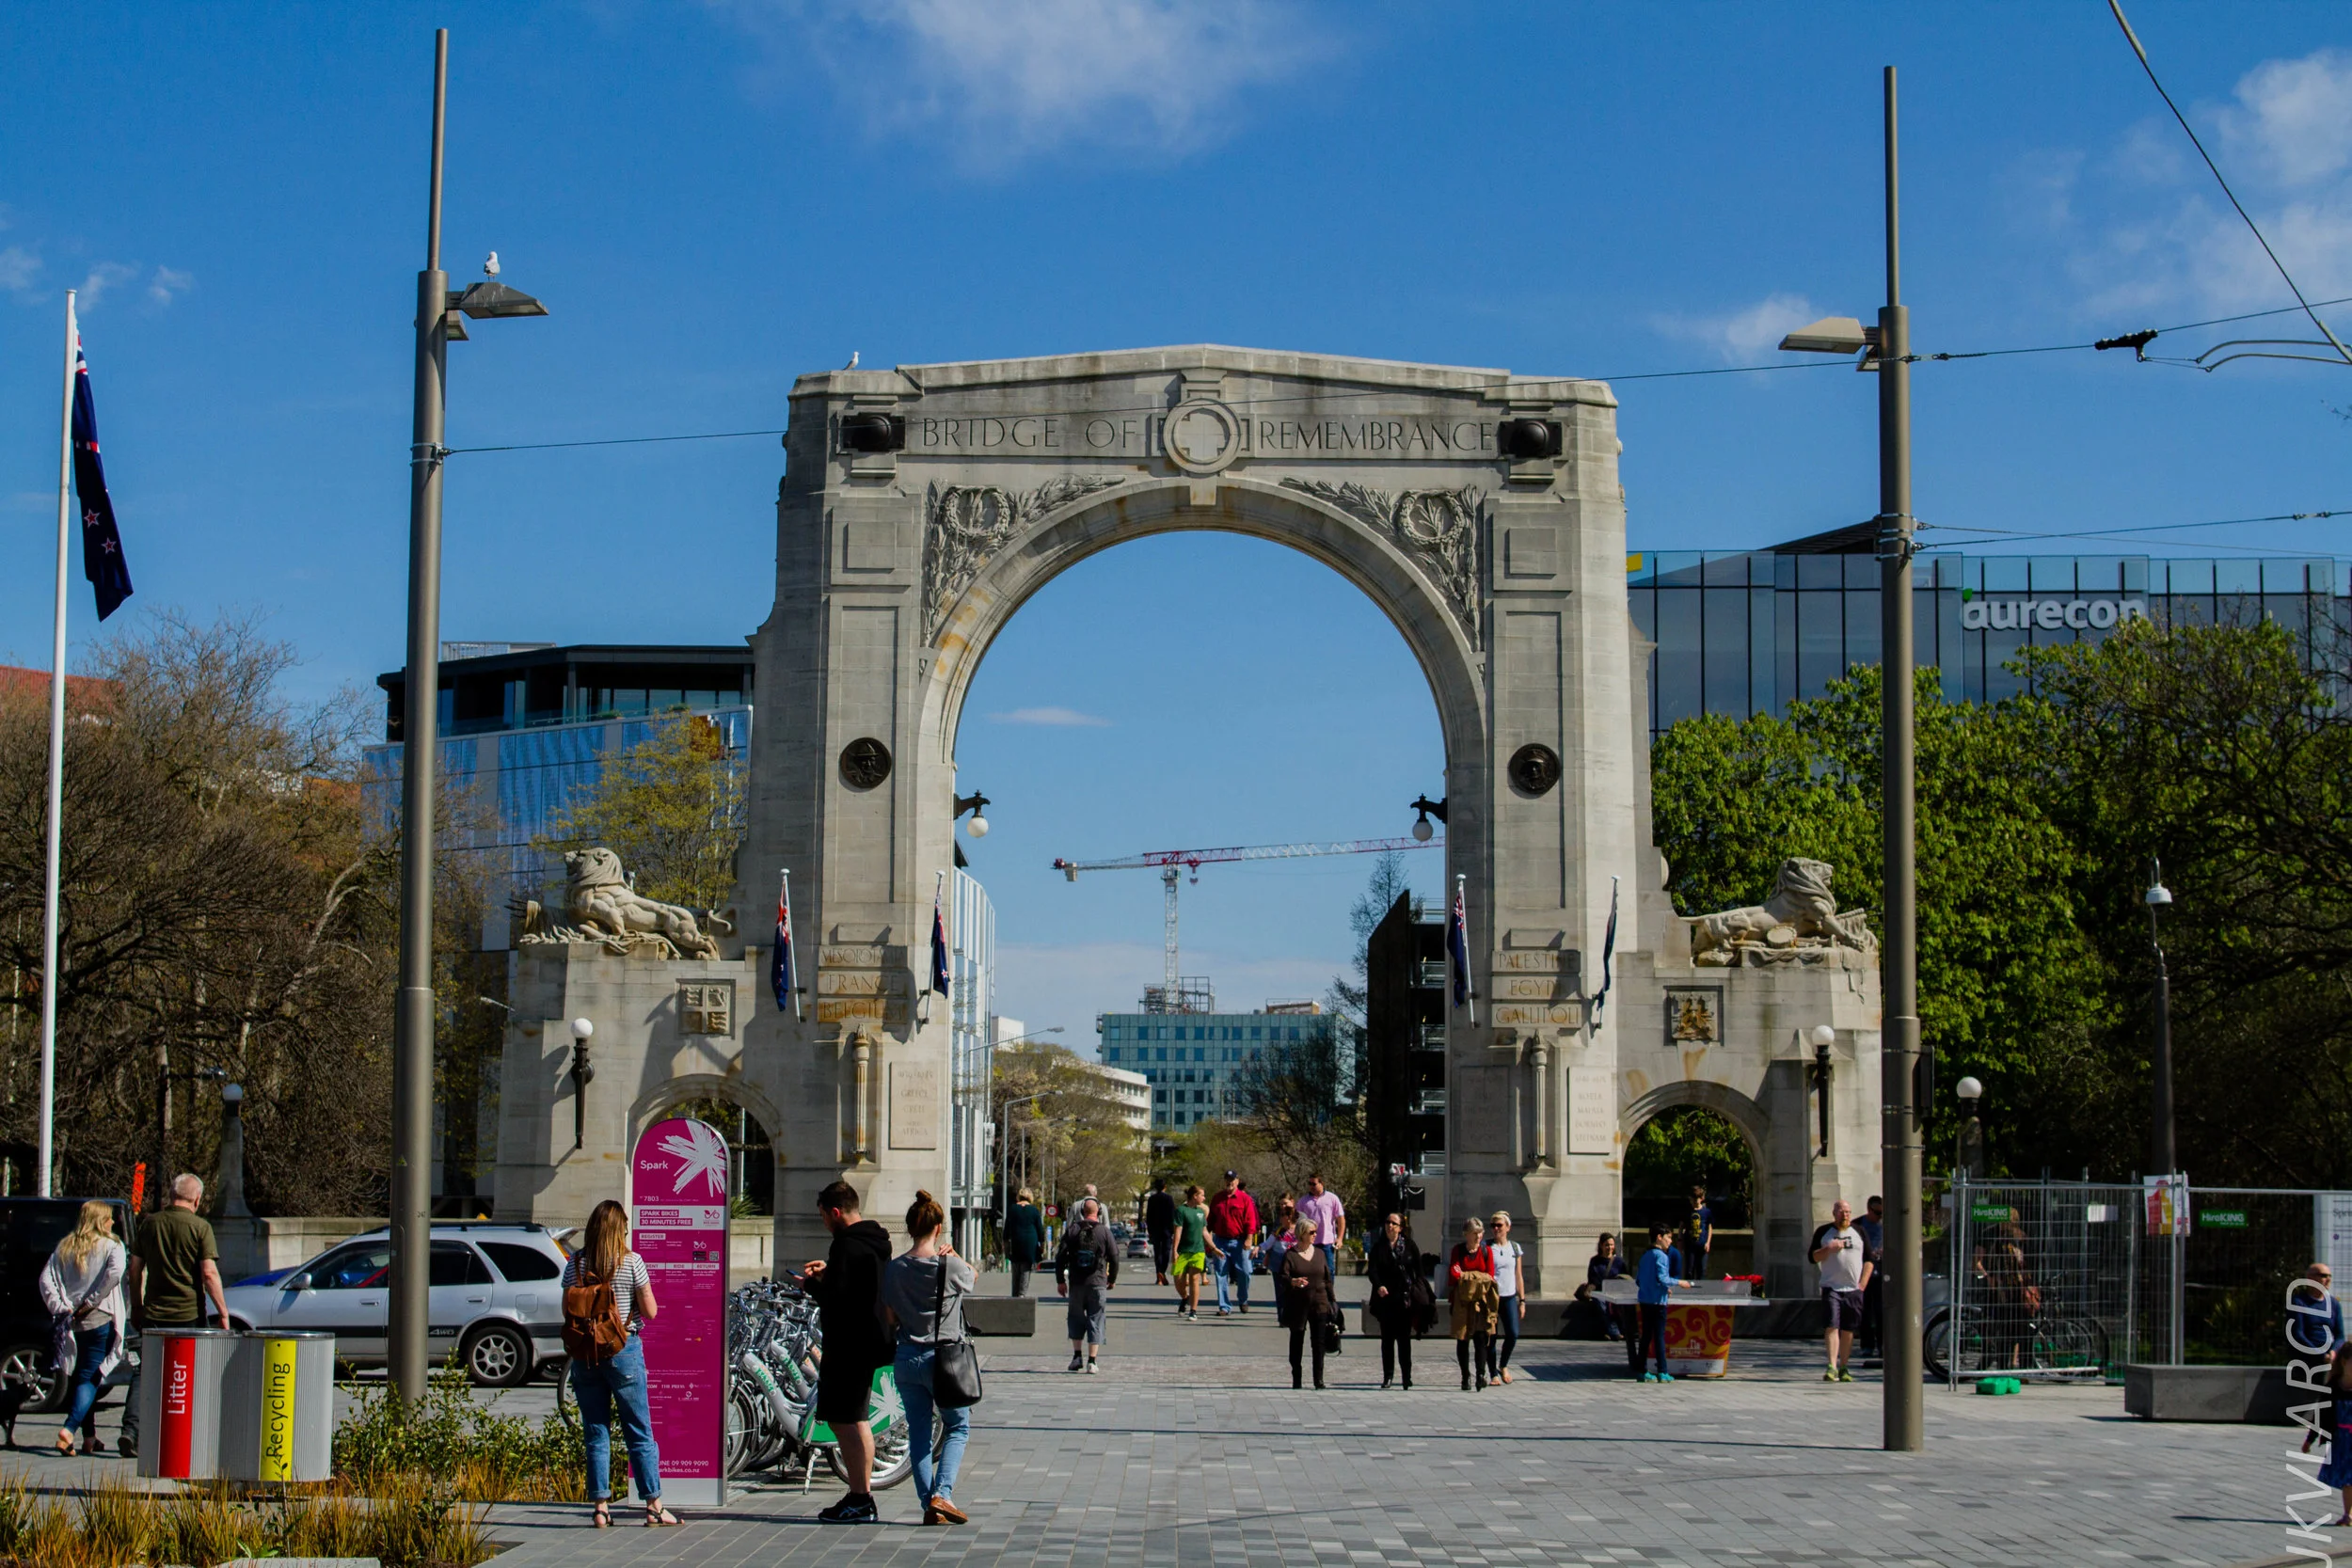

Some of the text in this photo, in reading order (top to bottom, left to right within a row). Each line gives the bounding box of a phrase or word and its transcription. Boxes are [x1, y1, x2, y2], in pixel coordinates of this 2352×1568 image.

[923, 418, 1137, 450] BRIDGE OF
[1259, 420, 1493, 451] REMEMBRANCE
[1963, 598, 2146, 630] aurecon
[1499, 953, 1576, 970] PALESTINE
[829, 974, 898, 991] FRANCE
[823, 1002, 904, 1022] BELGIUM
[1496, 1007, 1580, 1024] GALLIPOLI
[640, 1160, 669, 1171] Spark
[429, 1327, 454, 1336] 4WD
[167, 1360, 187, 1415] Litter
[266, 1363, 291, 1458] Recycling
